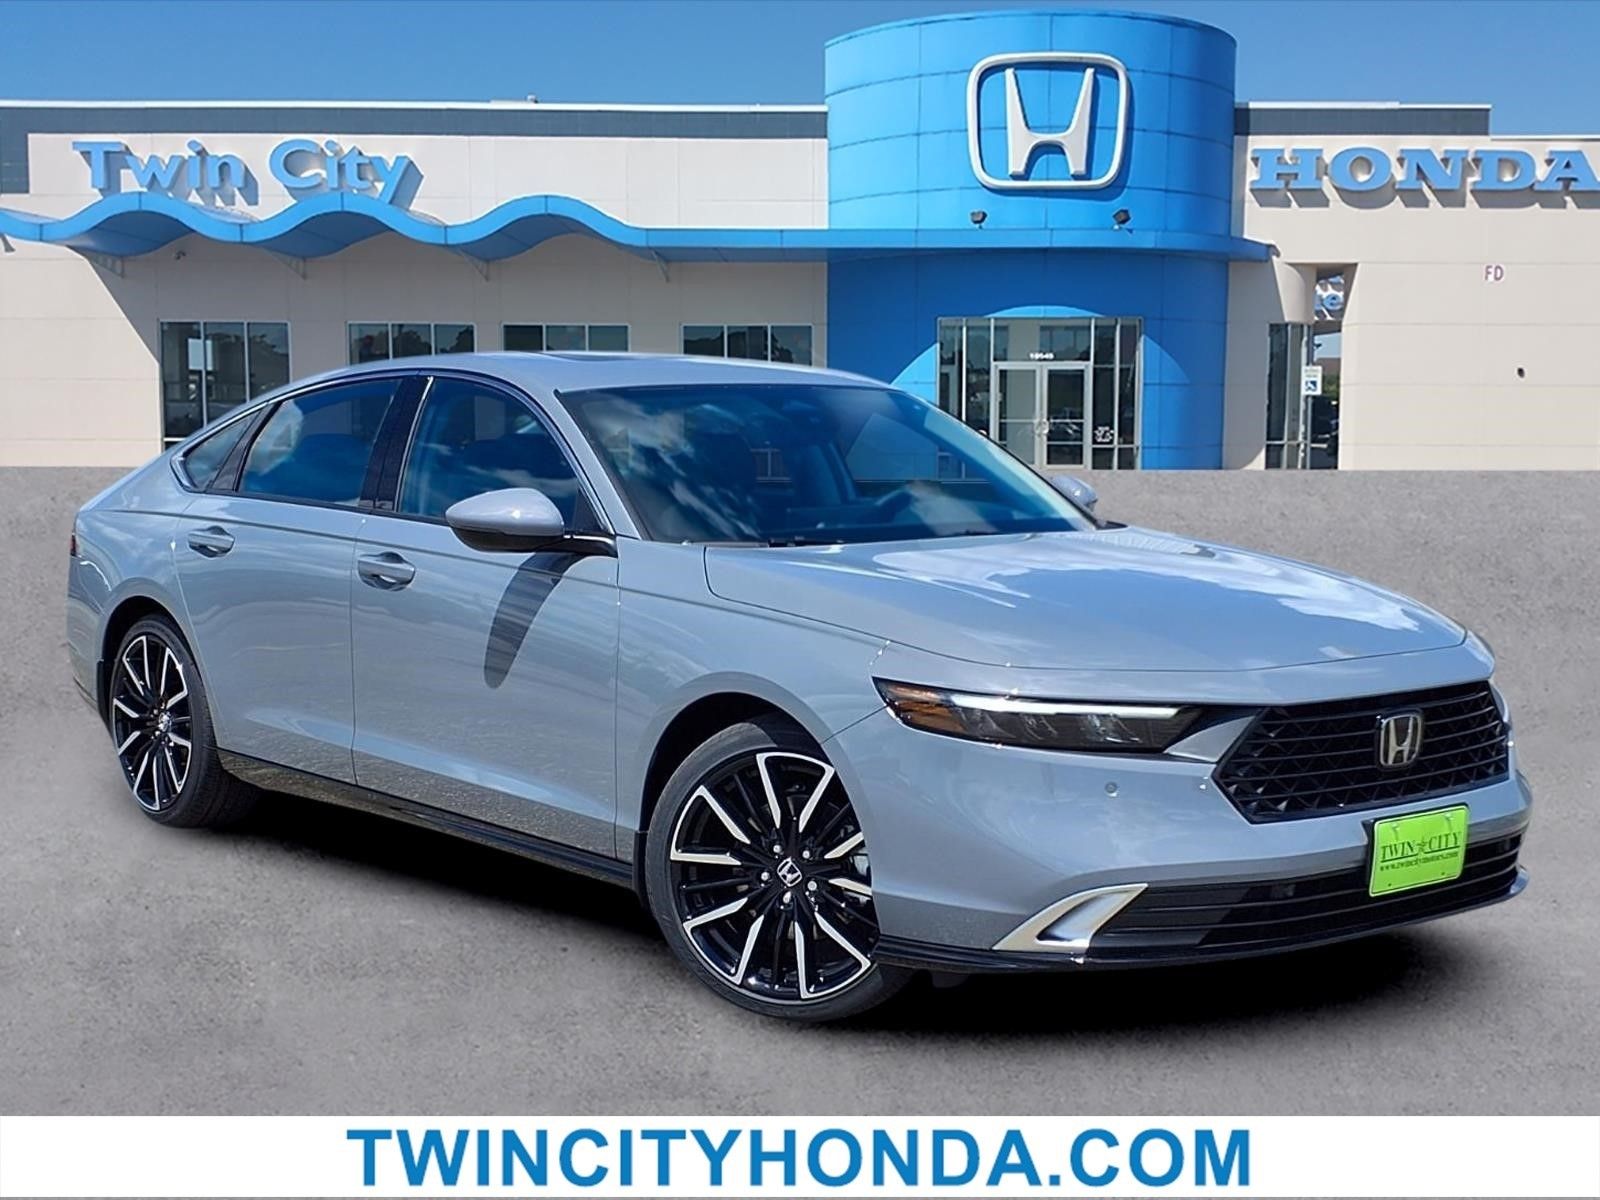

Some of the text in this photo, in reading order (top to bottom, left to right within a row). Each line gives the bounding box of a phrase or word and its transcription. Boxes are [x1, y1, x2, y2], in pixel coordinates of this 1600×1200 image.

[72, 138, 411, 205] Twin City
[1250, 146, 1600, 191] HONDA
[1484, 264, 1504, 281] FD
[1380, 831, 1462, 860] TWIN CITY
